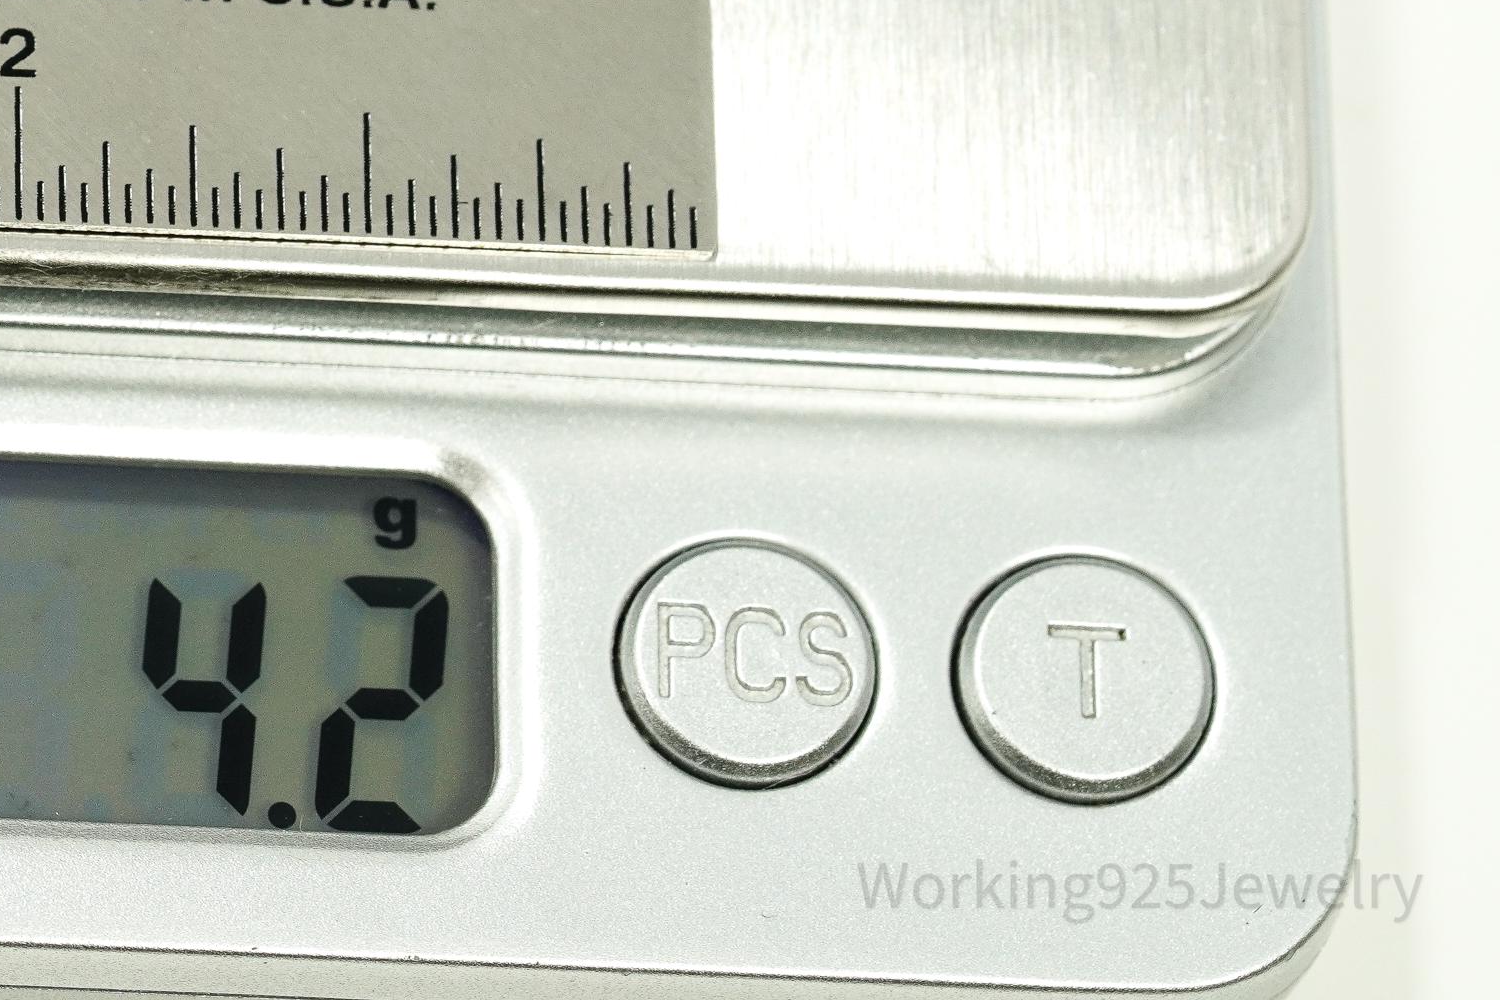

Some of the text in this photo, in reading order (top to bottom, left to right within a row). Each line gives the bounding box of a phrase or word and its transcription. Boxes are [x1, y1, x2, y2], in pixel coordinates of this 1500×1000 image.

[0, 27, 37, 78] 2
[373, 496, 417, 550] g
[656, 600, 856, 709] PCS
[1046, 621, 1128, 720] T
[142, 575, 449, 836] 4.2
